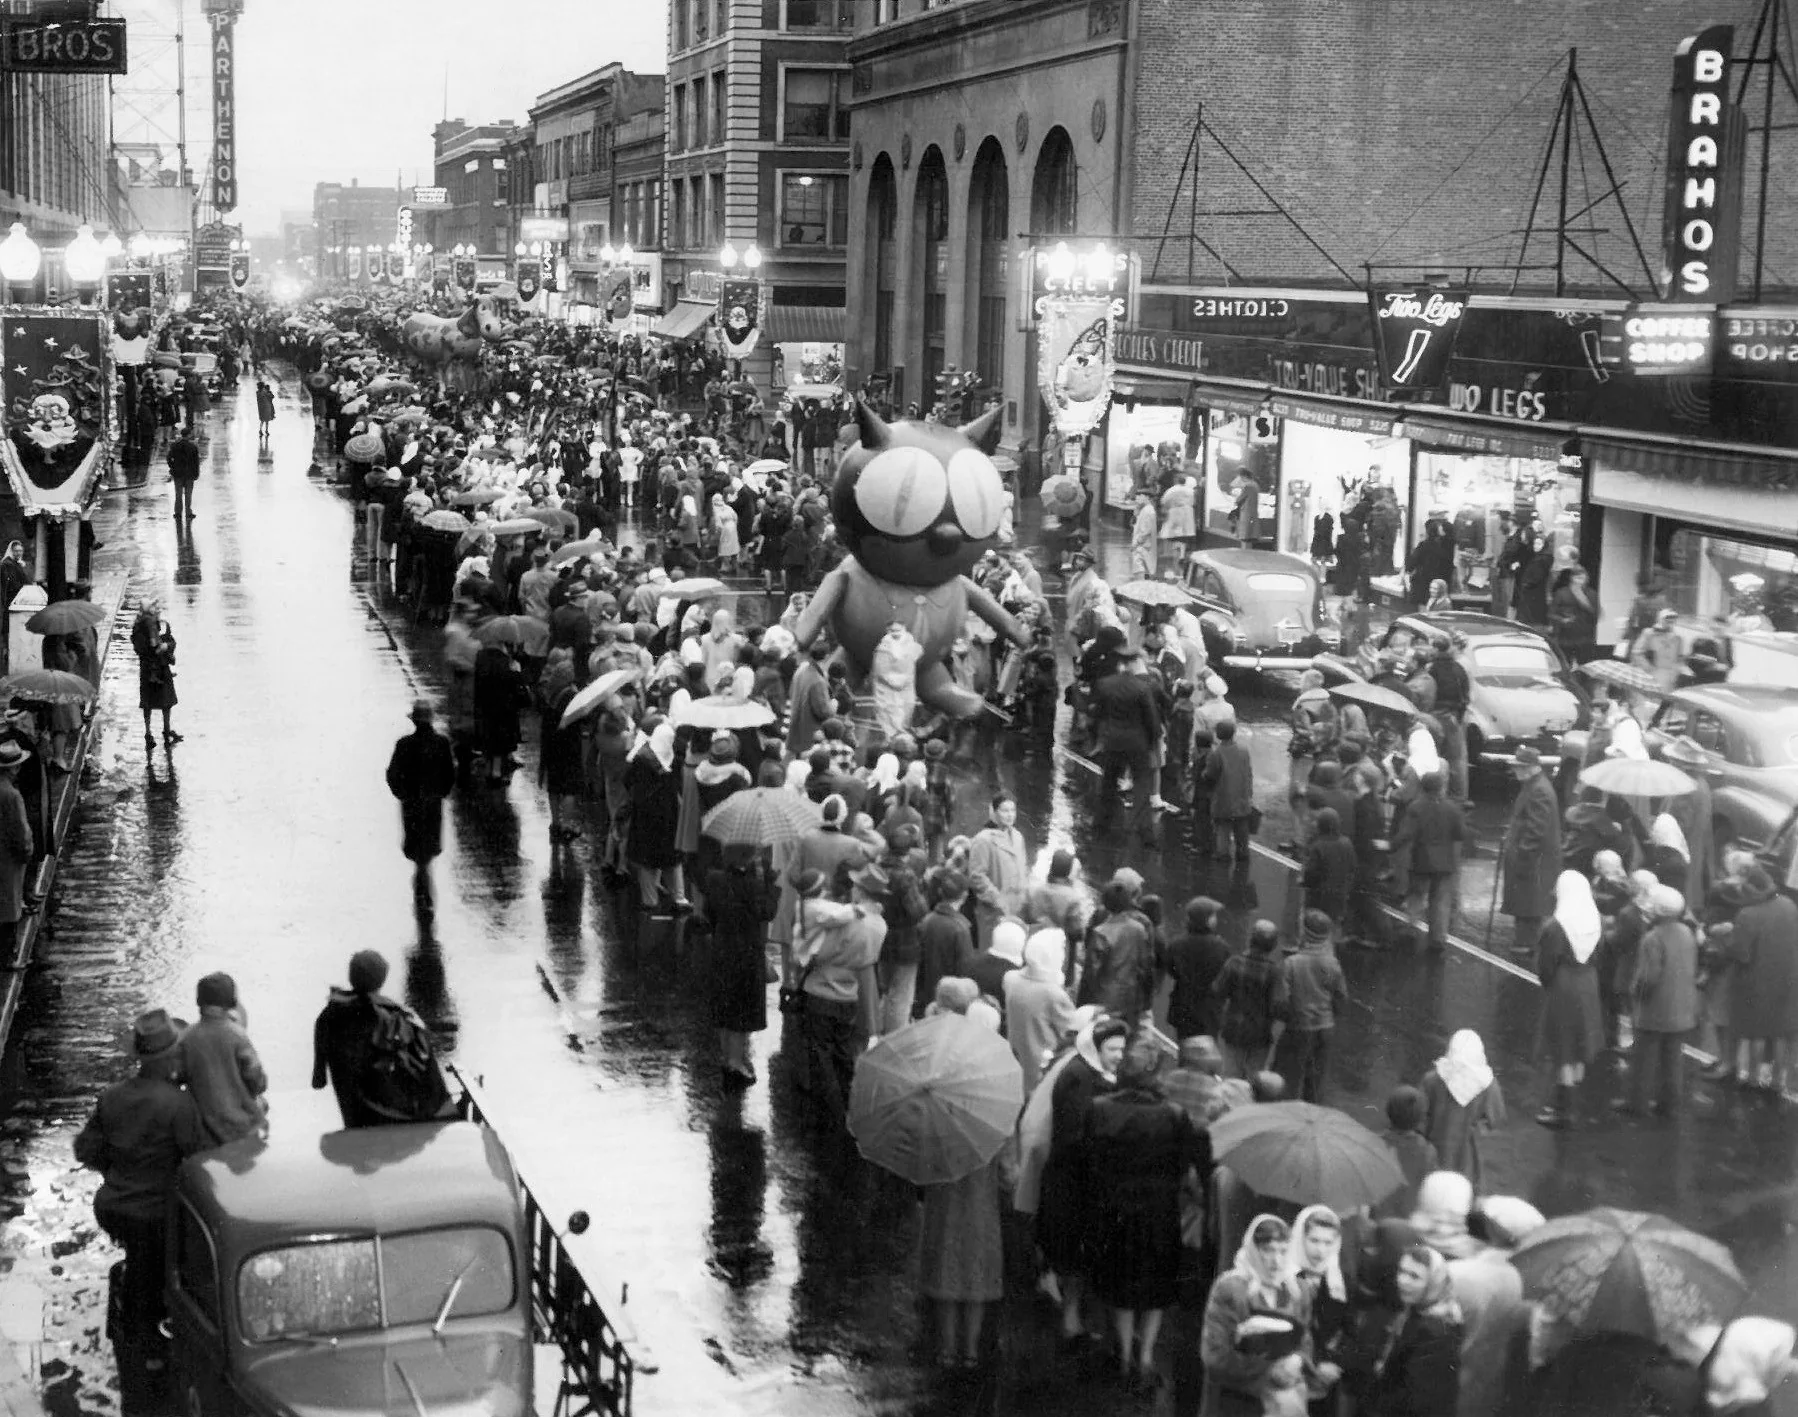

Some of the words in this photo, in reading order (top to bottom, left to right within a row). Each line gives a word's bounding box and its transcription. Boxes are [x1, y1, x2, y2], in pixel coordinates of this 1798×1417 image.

[19, 29, 113, 61] BROS
[215, 14, 231, 203] PARTHENON
[1680, 49, 1724, 294] BRAHOS
[1418, 293, 1464, 327] Legs
[1625, 318, 1711, 338] COFFEE
[1628, 342, 1706, 363] SHOP
[1490, 387, 1546, 421] LEGS
